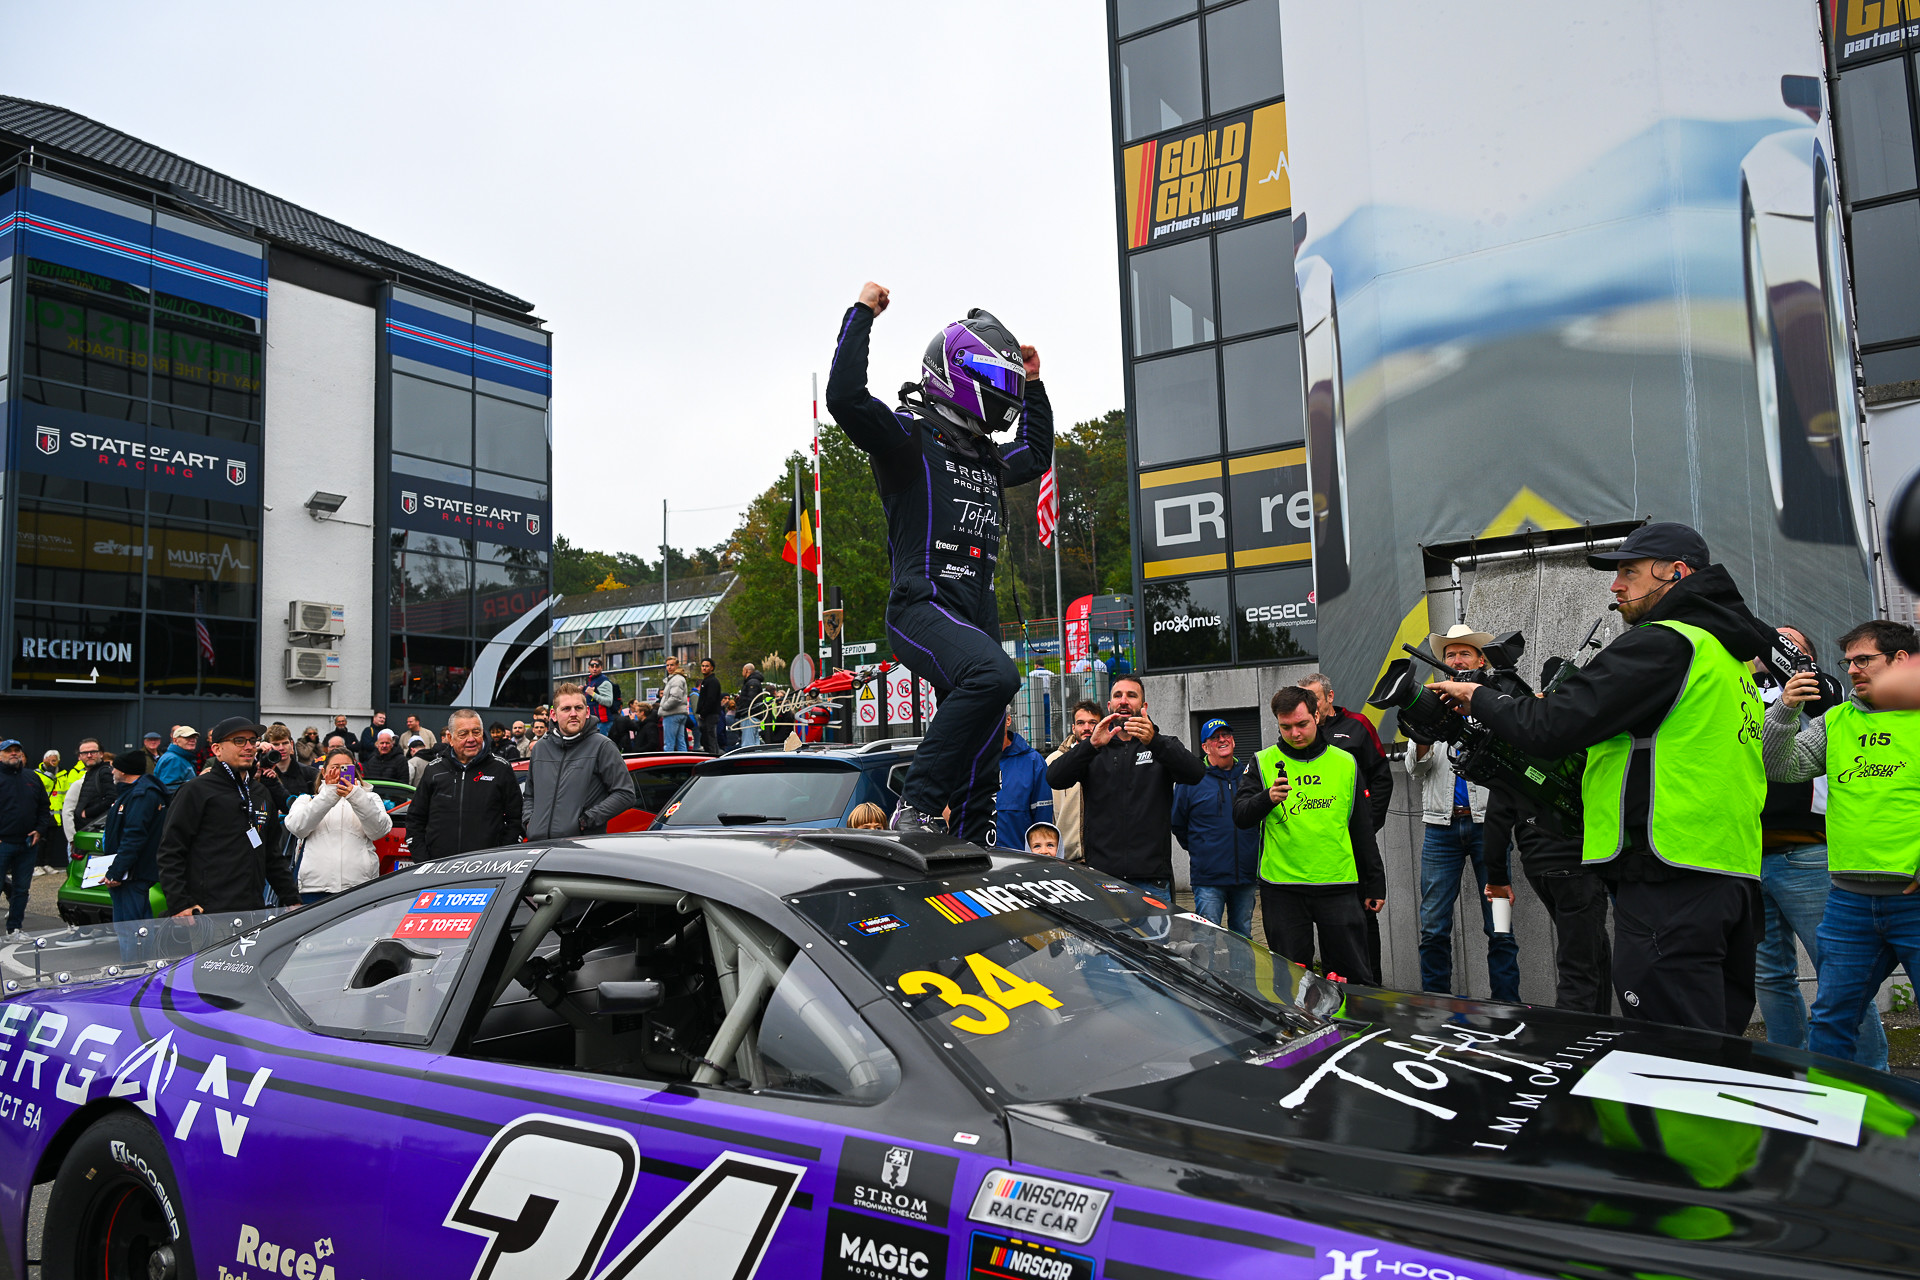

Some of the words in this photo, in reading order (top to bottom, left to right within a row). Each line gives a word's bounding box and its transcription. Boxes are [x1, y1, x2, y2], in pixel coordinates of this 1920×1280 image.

[1843, 24, 1919, 58] partners
[1160, 122, 1246, 181] GOLD
[1156, 163, 1243, 222] GRID
[1154, 214, 1203, 239] partners
[1202, 206, 1239, 225] lounge
[70, 432, 146, 459] STATE
[150, 446, 170, 457] OF
[171, 451, 219, 470] ART
[99, 455, 193, 478] RACING
[423, 495, 473, 515] STATE
[475, 505, 489, 513] OF
[489, 508, 522, 523] ART
[442, 513, 505, 530] RACING
[1080, 604, 1089, 634] ZONE
[1153, 614, 1222, 635] proximus
[1245, 602, 1308, 622] essec
[22, 636, 132, 663] RECEPTION
[841, 645, 867, 655] CEPTION
[1208, 720, 1226, 729] DTM
[1858, 732, 1892, 747] 165
[1295, 775, 1321, 786] 102
[1856, 770, 1894, 778] ZOLDER
[1864, 763, 1901, 772] CRCUIT
[433, 894, 441, 906] T.
[447, 893, 487, 906] TOFFEL
[417, 919, 425, 931] T.
[431, 918, 472, 932] TOFFEL
[226, 962, 255, 975] aviation
[897, 952, 1064, 1036] 34
[1472, 1028, 1626, 1151] IMMOBILIER
[0, 1091, 22, 1120] CT
[23, 1103, 42, 1131] SA
[126, 1149, 181, 1242] HOOSIER
[854, 1185, 928, 1213] STROM
[1017, 1181, 1089, 1214] NASCAR
[853, 1199, 927, 1221] STROMWATCHES.COM
[988, 1201, 1037, 1223] RACE
[1041, 1209, 1078, 1233] CAR
[1008, 1250, 1072, 1280] NASCAR
[1376, 1260, 1475, 1280] HOO
